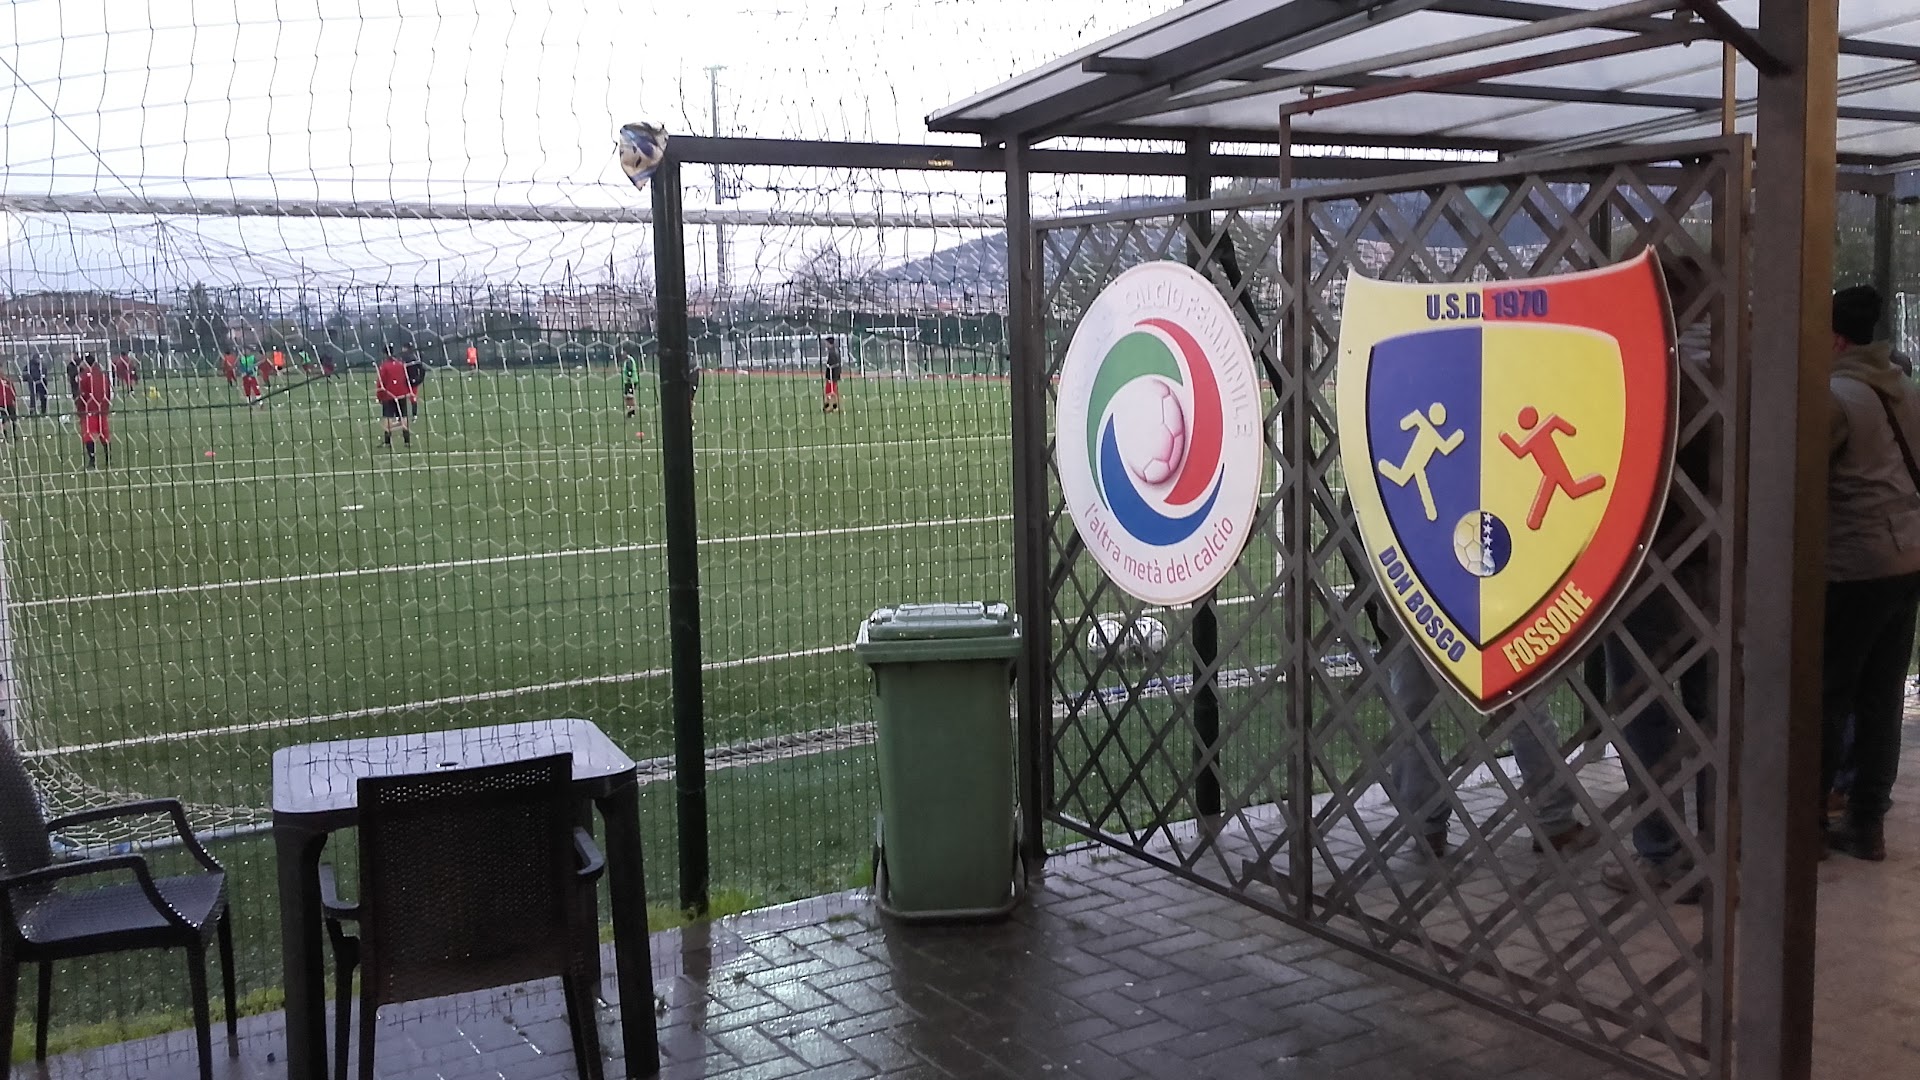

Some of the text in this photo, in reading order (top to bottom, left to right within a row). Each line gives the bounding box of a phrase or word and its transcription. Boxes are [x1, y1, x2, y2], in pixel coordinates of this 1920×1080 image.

[1426, 288, 1549, 320] U.S.D. 1970
[1084, 502, 1234, 584] l'altra metà del calcio
[1378, 545, 1467, 663] DON BOSCO
[1501, 580, 1594, 673] FOSSONE
